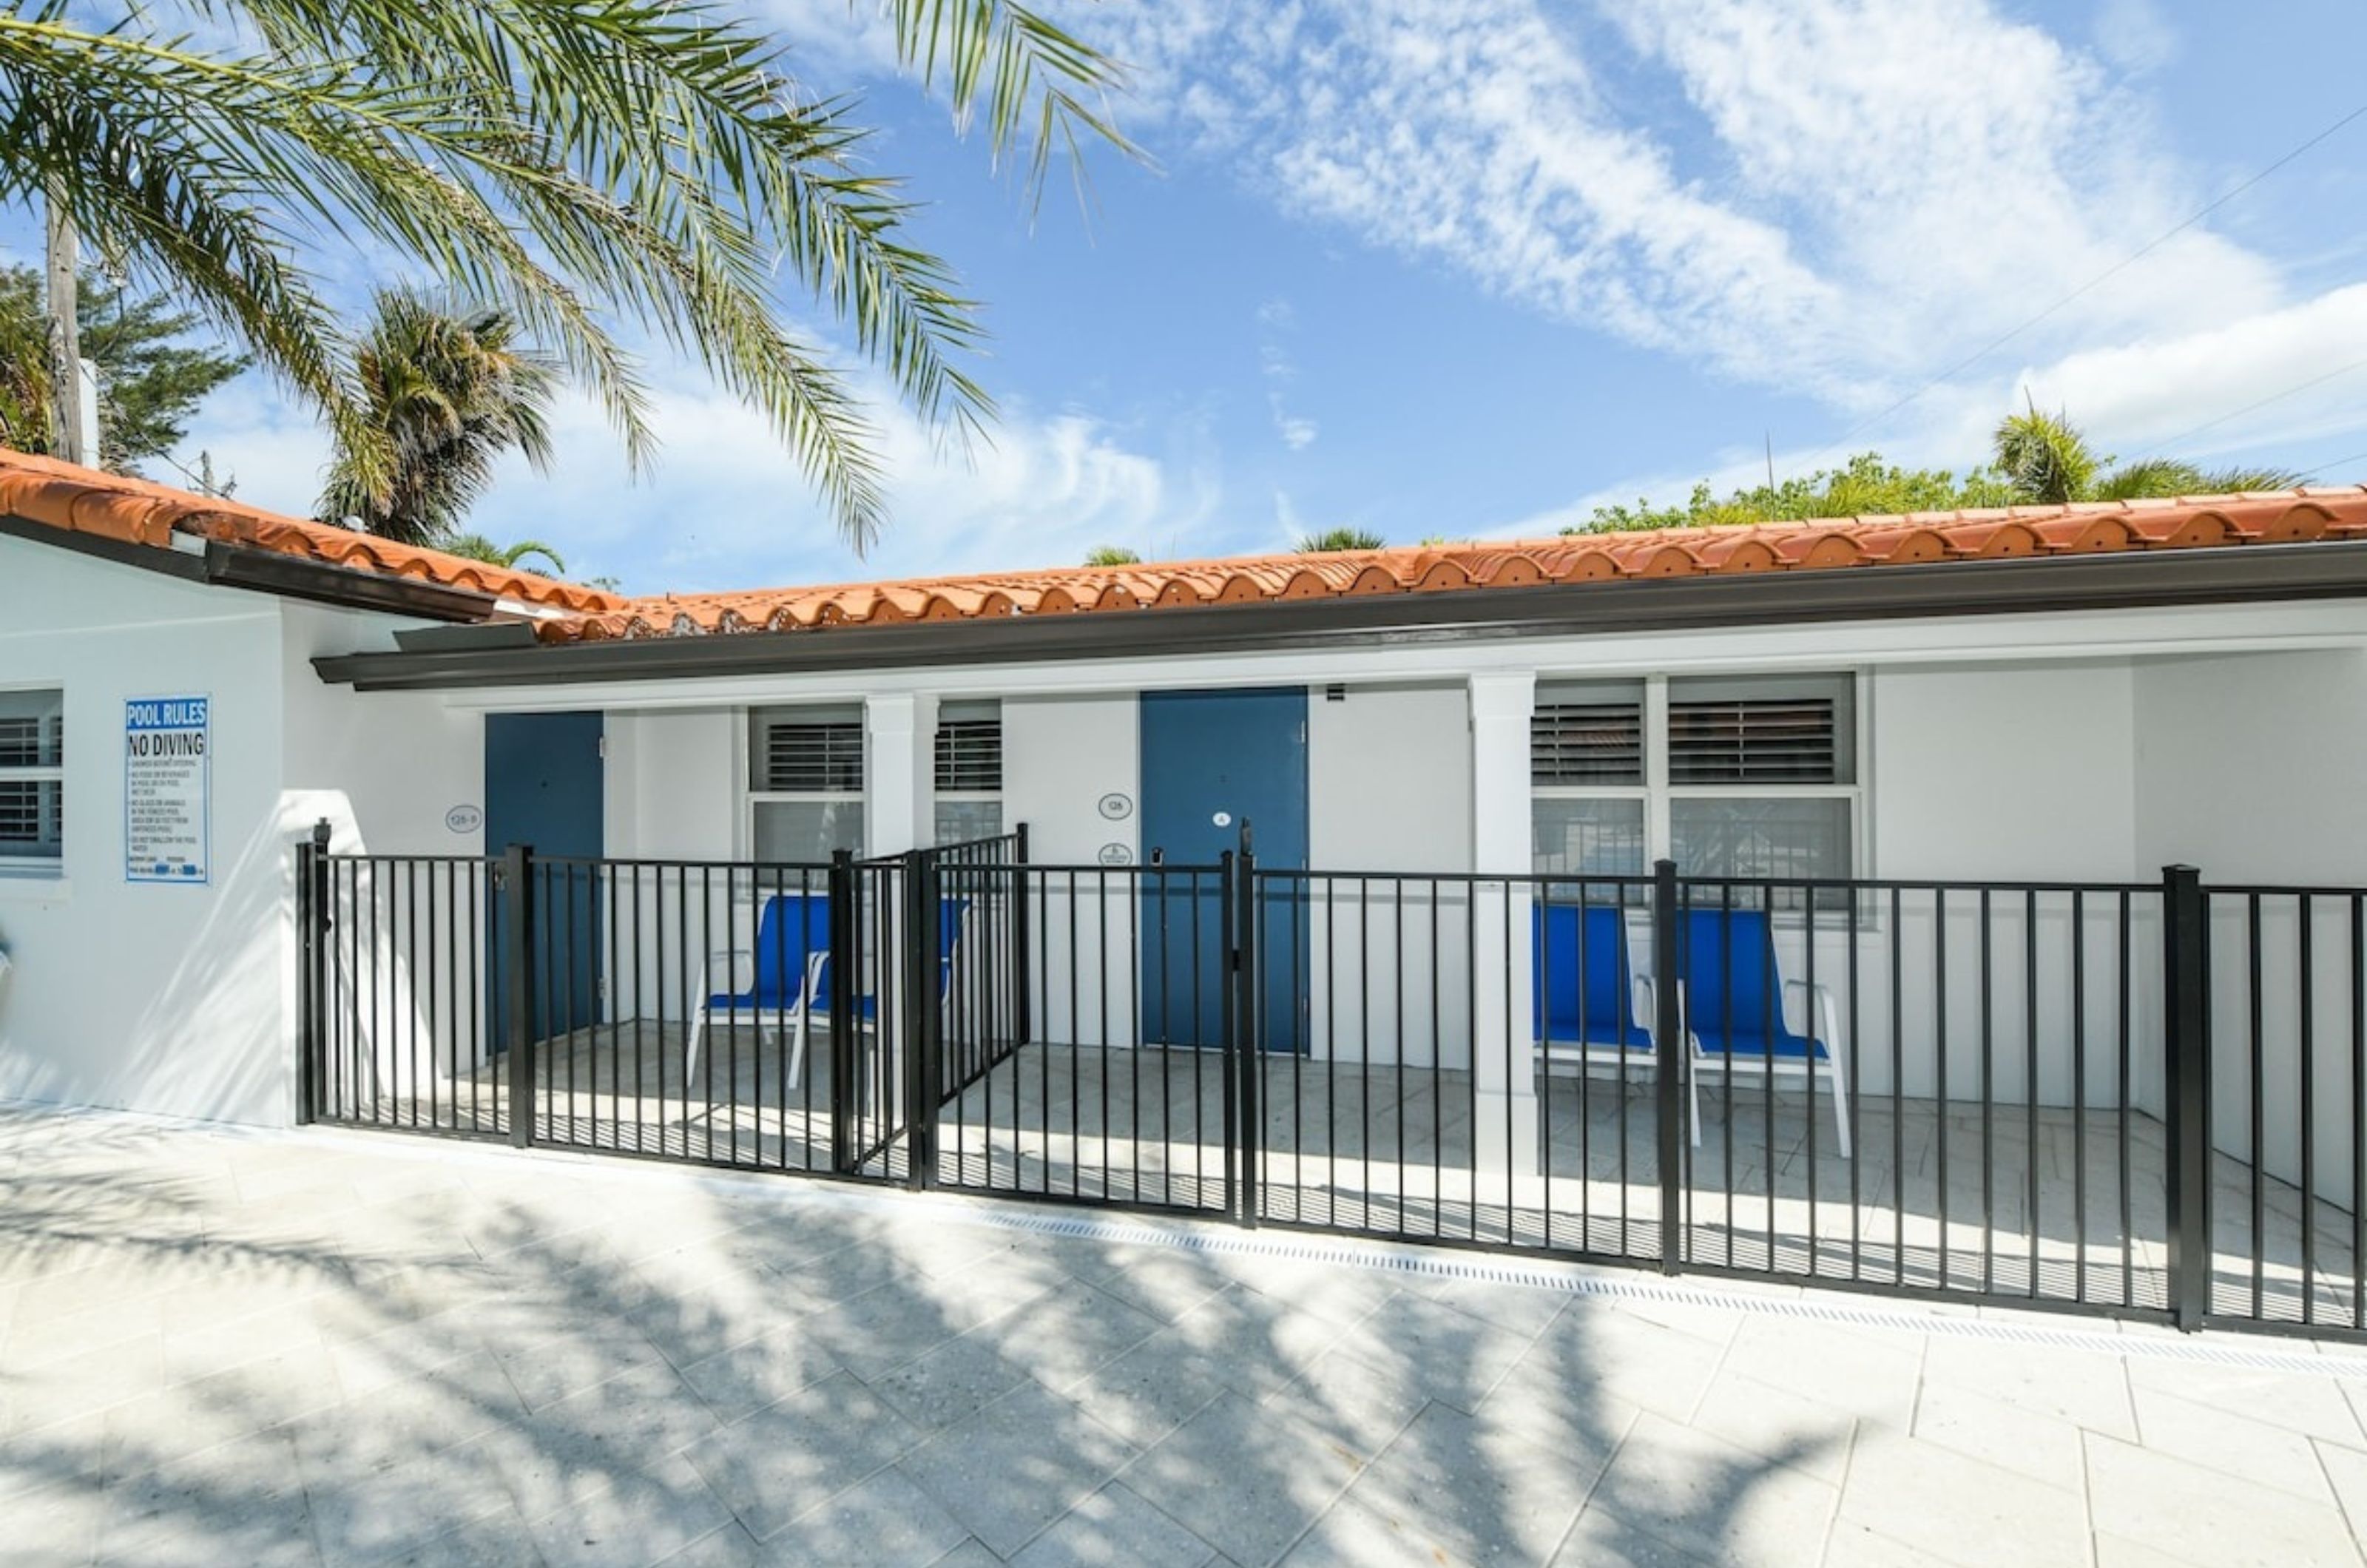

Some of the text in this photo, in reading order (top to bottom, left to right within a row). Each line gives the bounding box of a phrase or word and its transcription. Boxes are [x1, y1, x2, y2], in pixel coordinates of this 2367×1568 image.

[127, 701, 206, 726] POOL RULES
[129, 732, 204, 757] NO DIVING
